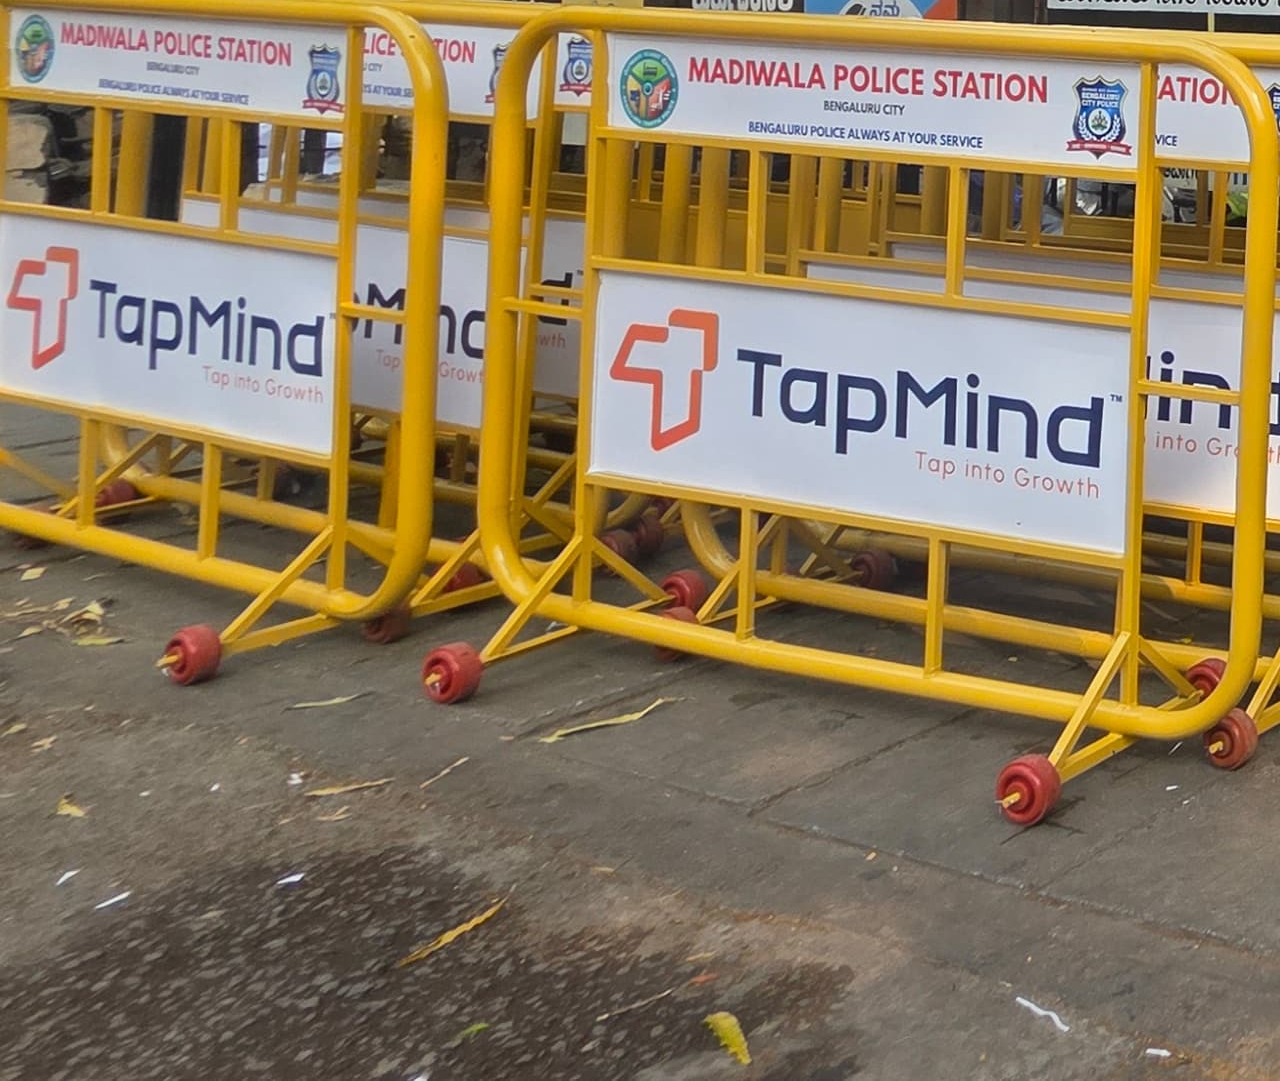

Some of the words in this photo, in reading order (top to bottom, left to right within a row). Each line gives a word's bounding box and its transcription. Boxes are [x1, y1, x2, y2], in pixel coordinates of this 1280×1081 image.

[60, 22, 149, 52] MADIWALA
[154, 31, 212, 59] POLICE
[217, 37, 292, 66] STATION
[362, 32, 396, 57] LICE
[432, 39, 477, 64] TION
[688, 57, 826, 90] MADIWALA
[834, 64, 924, 96] POLICE
[932, 69, 1048, 103] STATION
[1157, 75, 1239, 106] ATION
[823, 100, 882, 115] BENGALURU
[883, 104, 905, 116] CITY
[748, 121, 808, 136] BENGALURU
[810, 124, 846, 139] POLICE
[847, 127, 891, 142] ALWAYS
[892, 130, 906, 144] AT
[906, 131, 939, 146] YOUR
[939, 134, 983, 149] SERVICE
[1155, 134, 1178, 147] VICE
[90, 279, 325, 377] TapMind
[376, 349, 401, 373] Tap
[439, 361, 484, 384] Growt
[203, 365, 230, 390] Tap
[234, 369, 260, 393] into
[265, 378, 324, 404] Growth
[737, 348, 1104, 469] TapMind
[1156, 432, 1197, 453] into
[915, 450, 956, 479] Tap
[965, 461, 1005, 485] into
[1014, 466, 1101, 500] Growth
